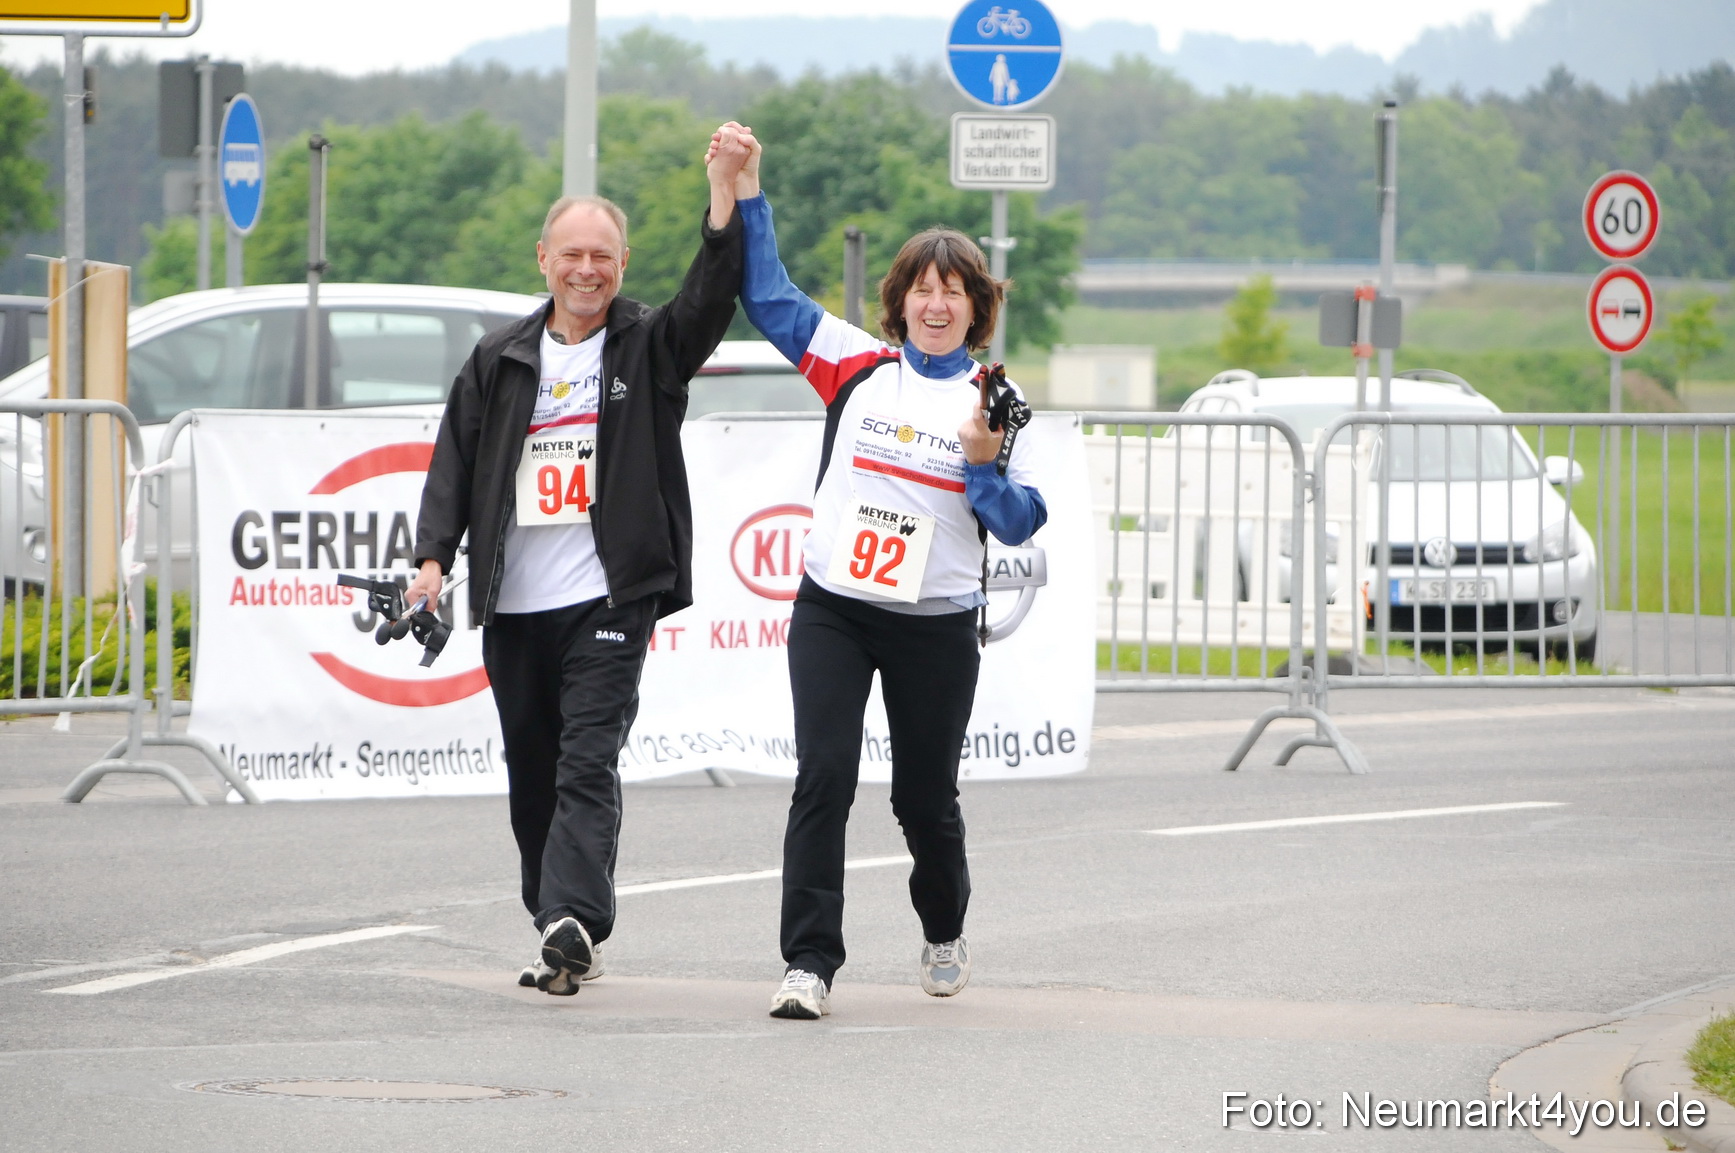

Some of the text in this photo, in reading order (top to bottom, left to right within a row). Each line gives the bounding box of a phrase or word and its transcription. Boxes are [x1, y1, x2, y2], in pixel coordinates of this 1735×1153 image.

[970, 124, 1036, 139] Landwirt-
[964, 143, 1042, 158] schaftlicher
[963, 162, 1042, 177] Verkehr frei
[1602, 198, 1642, 235] 60
[1010, 400, 1027, 423] LEKI
[531, 441, 573, 452] MEYER
[1002, 427, 1015, 455] LEKI
[531, 451, 575, 460] WERBUNG
[921, 463, 932, 471] Fax
[537, 464, 590, 515] 94
[857, 514, 897, 531] WERBUNG
[858, 505, 899, 523] MEYER
[849, 529, 906, 587] 92
[229, 575, 354, 606] Autohaus
[595, 630, 625, 641] JAKO
[710, 620, 749, 649] KIA
[356, 738, 495, 786] Sengenthal
